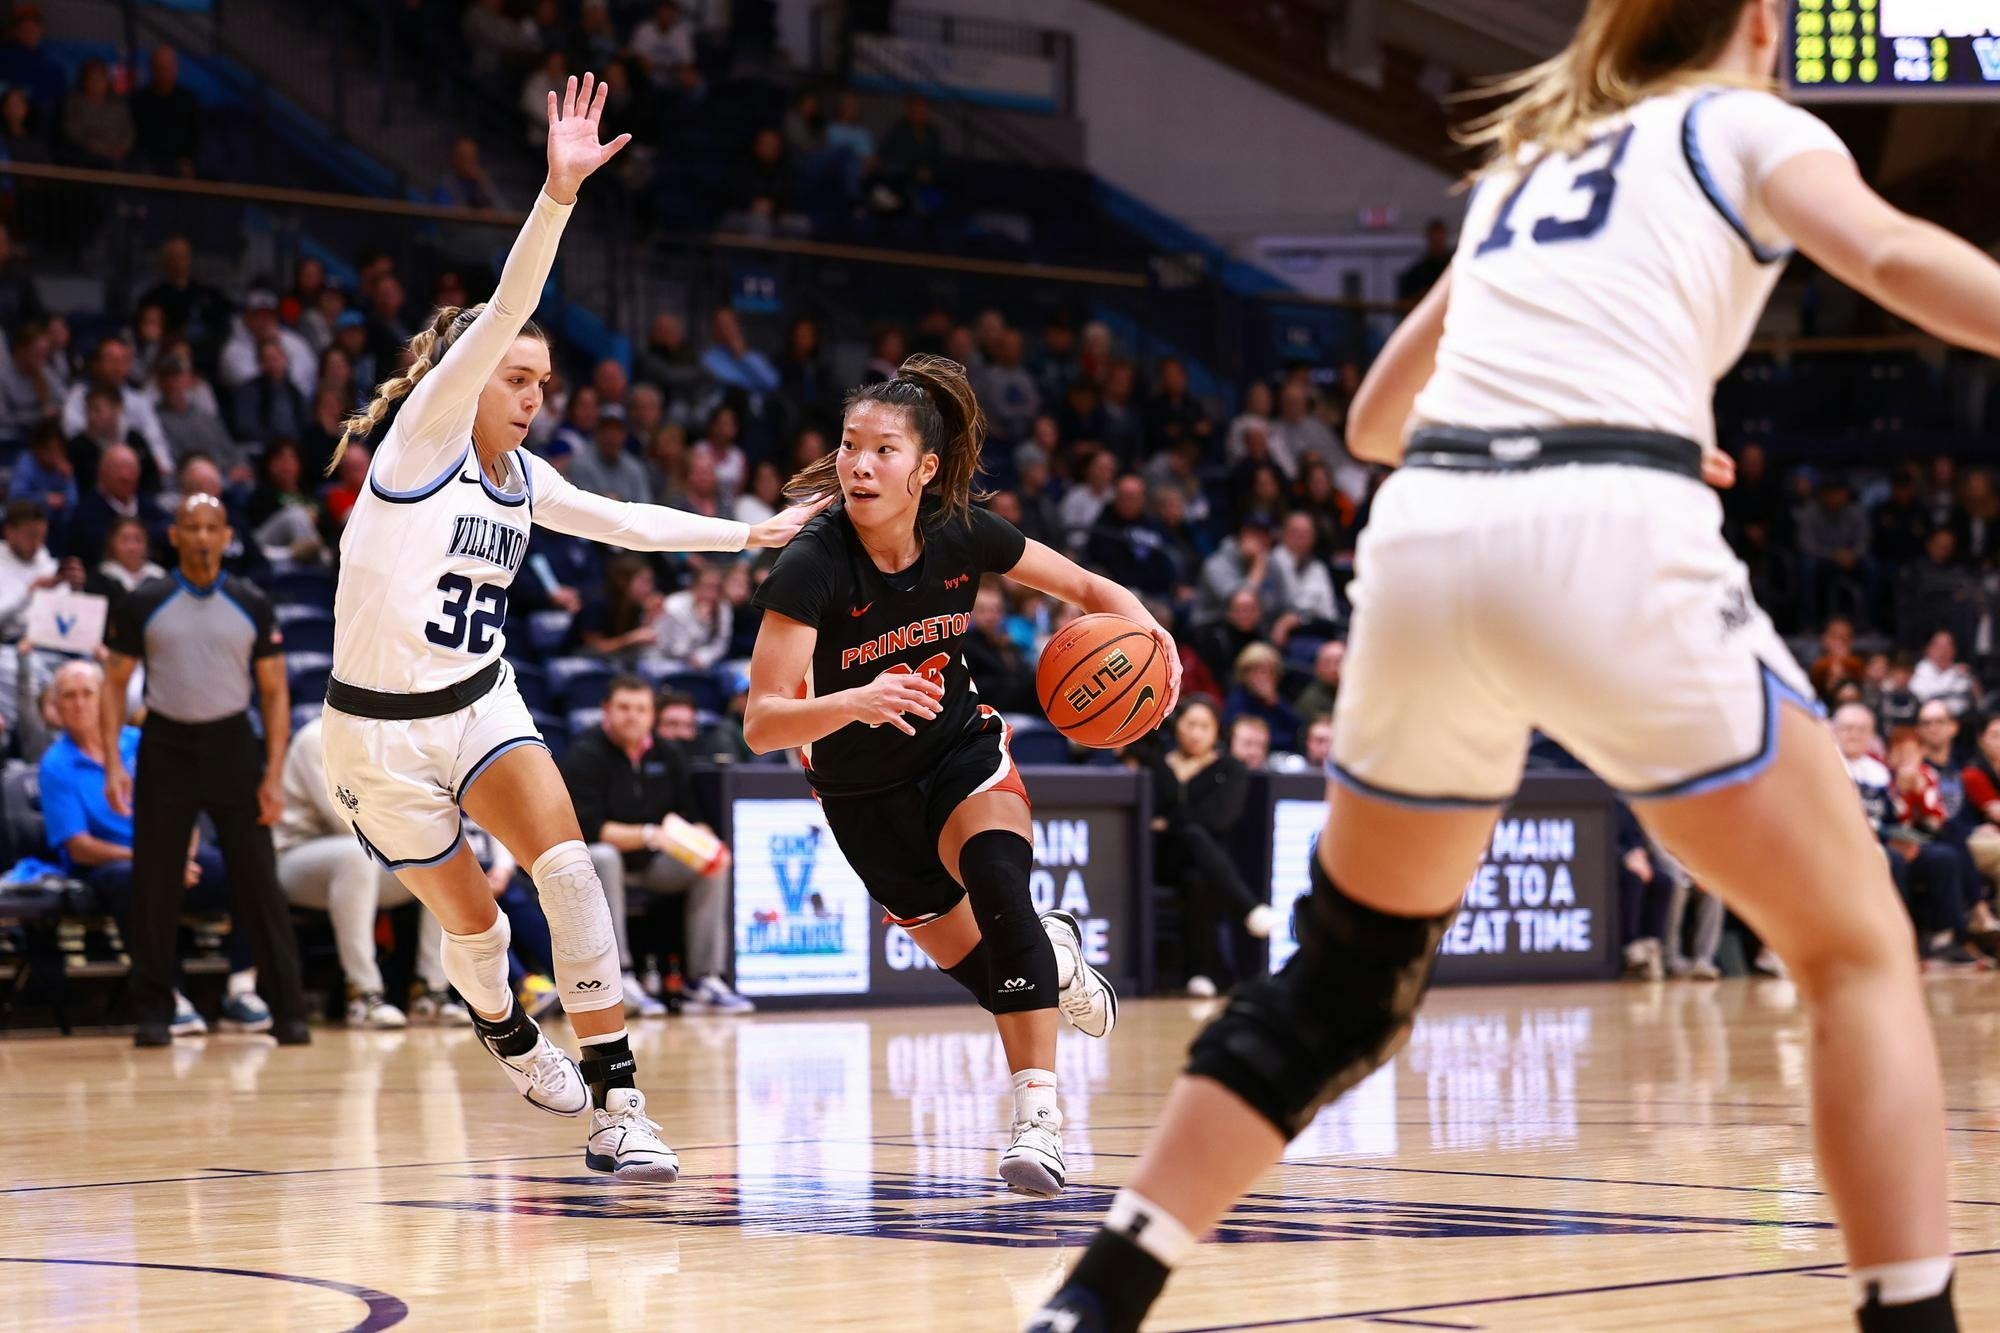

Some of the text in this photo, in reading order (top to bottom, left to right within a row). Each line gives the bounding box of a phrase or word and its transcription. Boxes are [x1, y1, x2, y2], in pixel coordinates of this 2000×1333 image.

[1474, 122, 1636, 259] 13
[446, 515, 529, 577] VILLANO
[944, 578, 959, 590] Ivy
[425, 572, 508, 654] 32
[1067, 652, 1134, 713] ELITE
[1032, 819, 1089, 866] AIN
[1492, 818, 1575, 862] MAIN
[1029, 869, 1090, 916] O A
[1503, 864, 1547, 907] TO
[1549, 863, 1576, 907] A
[1437, 908, 1592, 954] EAT TIME
